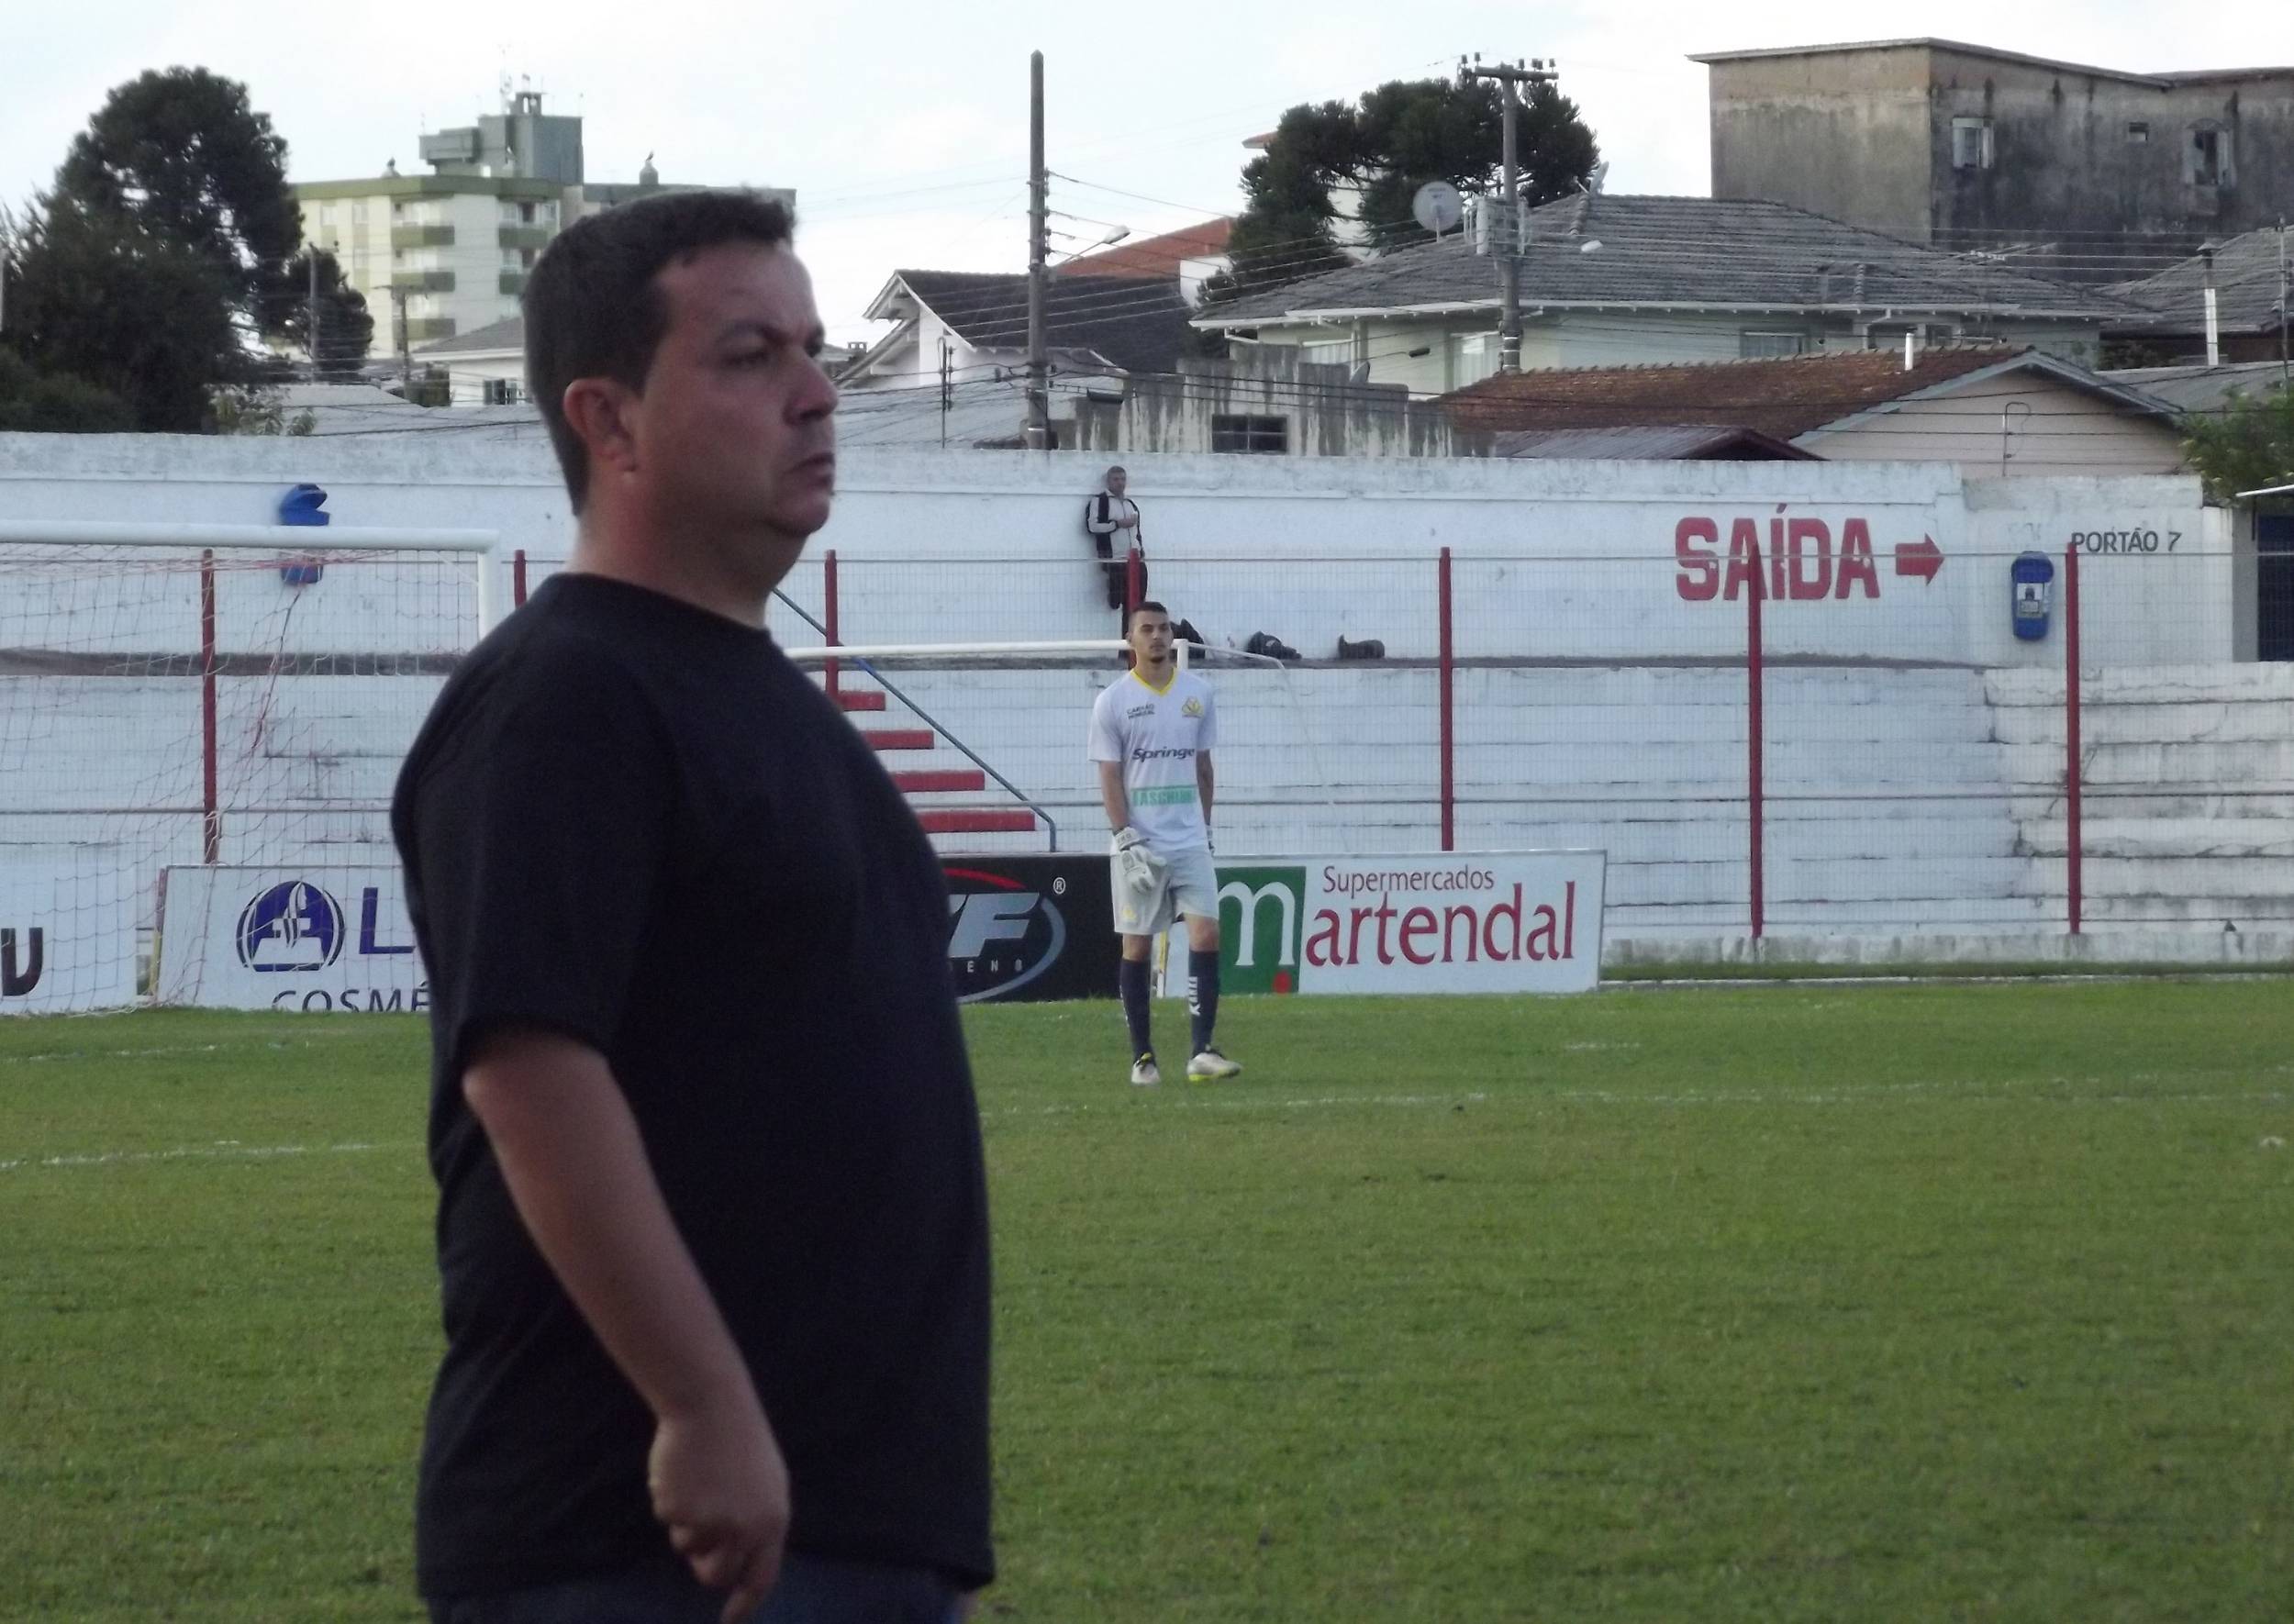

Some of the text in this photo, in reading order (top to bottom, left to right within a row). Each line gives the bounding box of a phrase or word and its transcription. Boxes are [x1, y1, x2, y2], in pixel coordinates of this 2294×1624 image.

[1675, 503, 1880, 601] SAÍDA
[2071, 527, 2182, 552] PORTÃO 7
[1322, 864, 1495, 899] Supermercados
